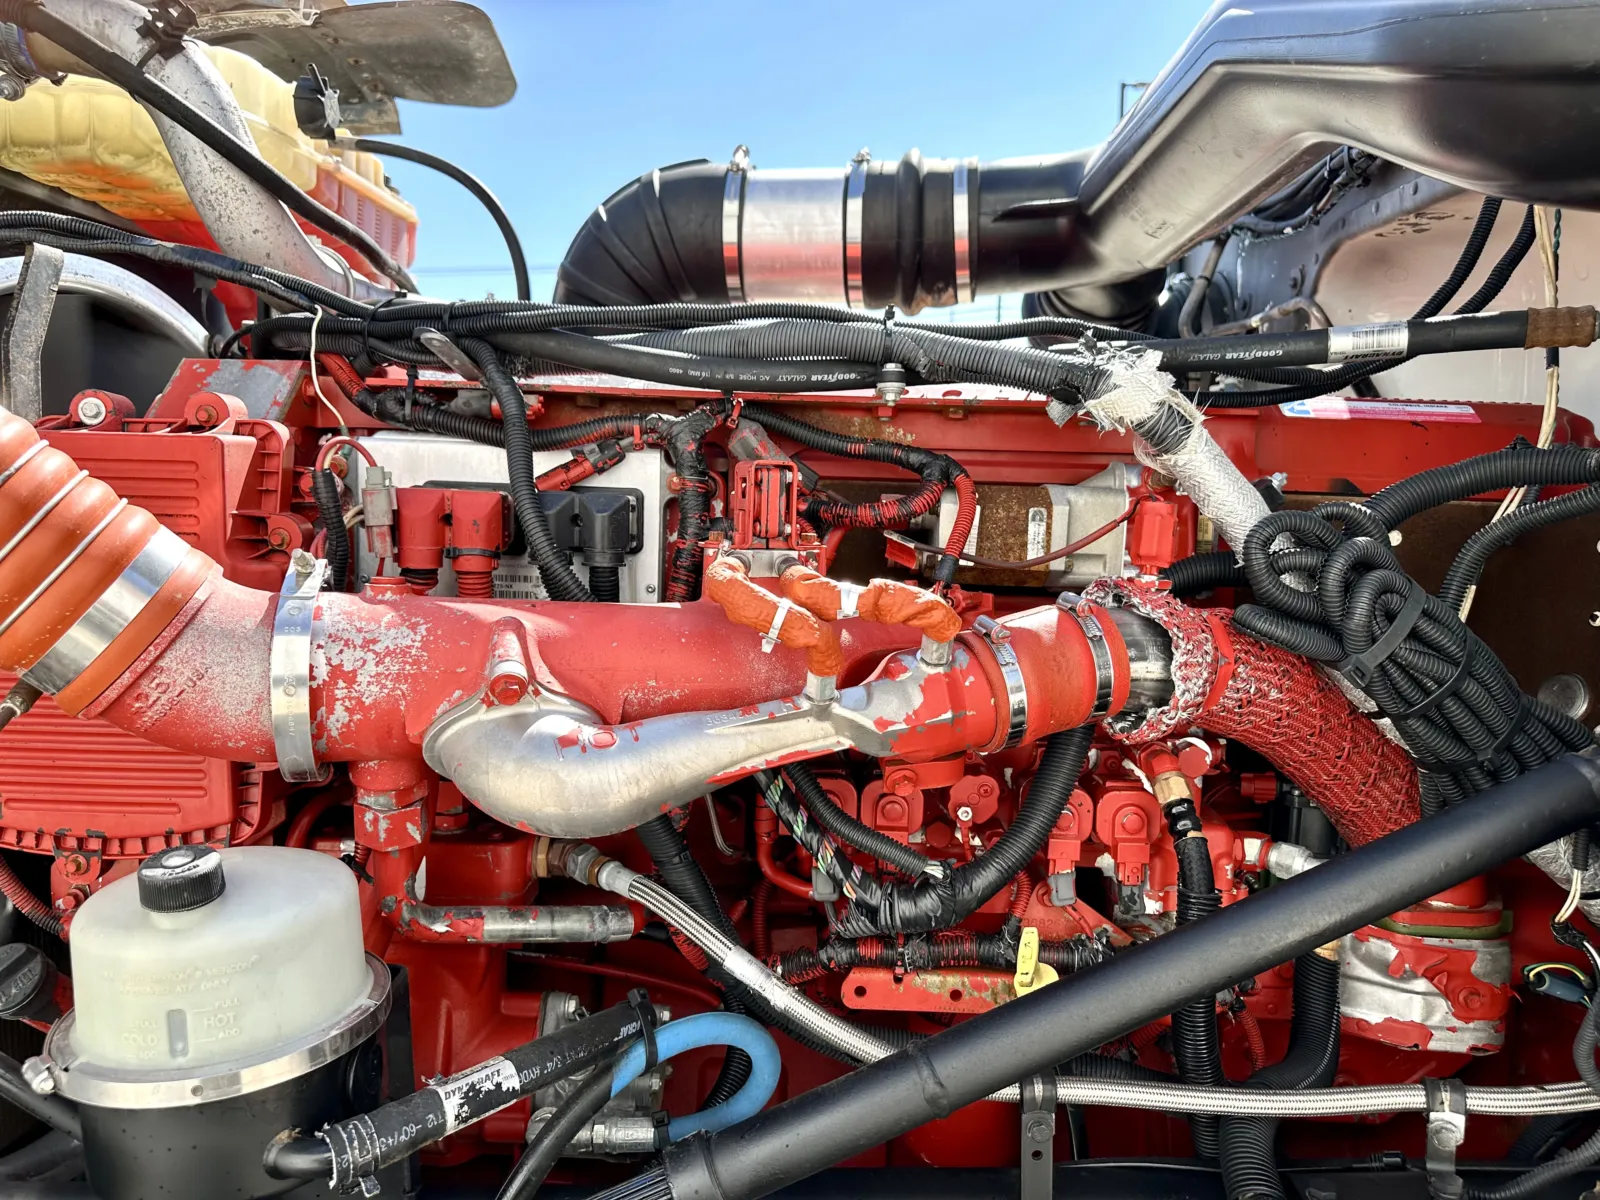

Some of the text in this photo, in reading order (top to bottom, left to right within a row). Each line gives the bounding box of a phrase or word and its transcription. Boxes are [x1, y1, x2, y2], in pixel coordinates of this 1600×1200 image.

[1188, 349, 1283, 362] GOODYEAR GALAXY
[777, 374, 807, 382] GALAXY
[215, 997, 241, 1009] FULL
[204, 1012, 236, 1029] HOT
[121, 1033, 158, 1047] COLD
[218, 1027, 241, 1040] ADD
